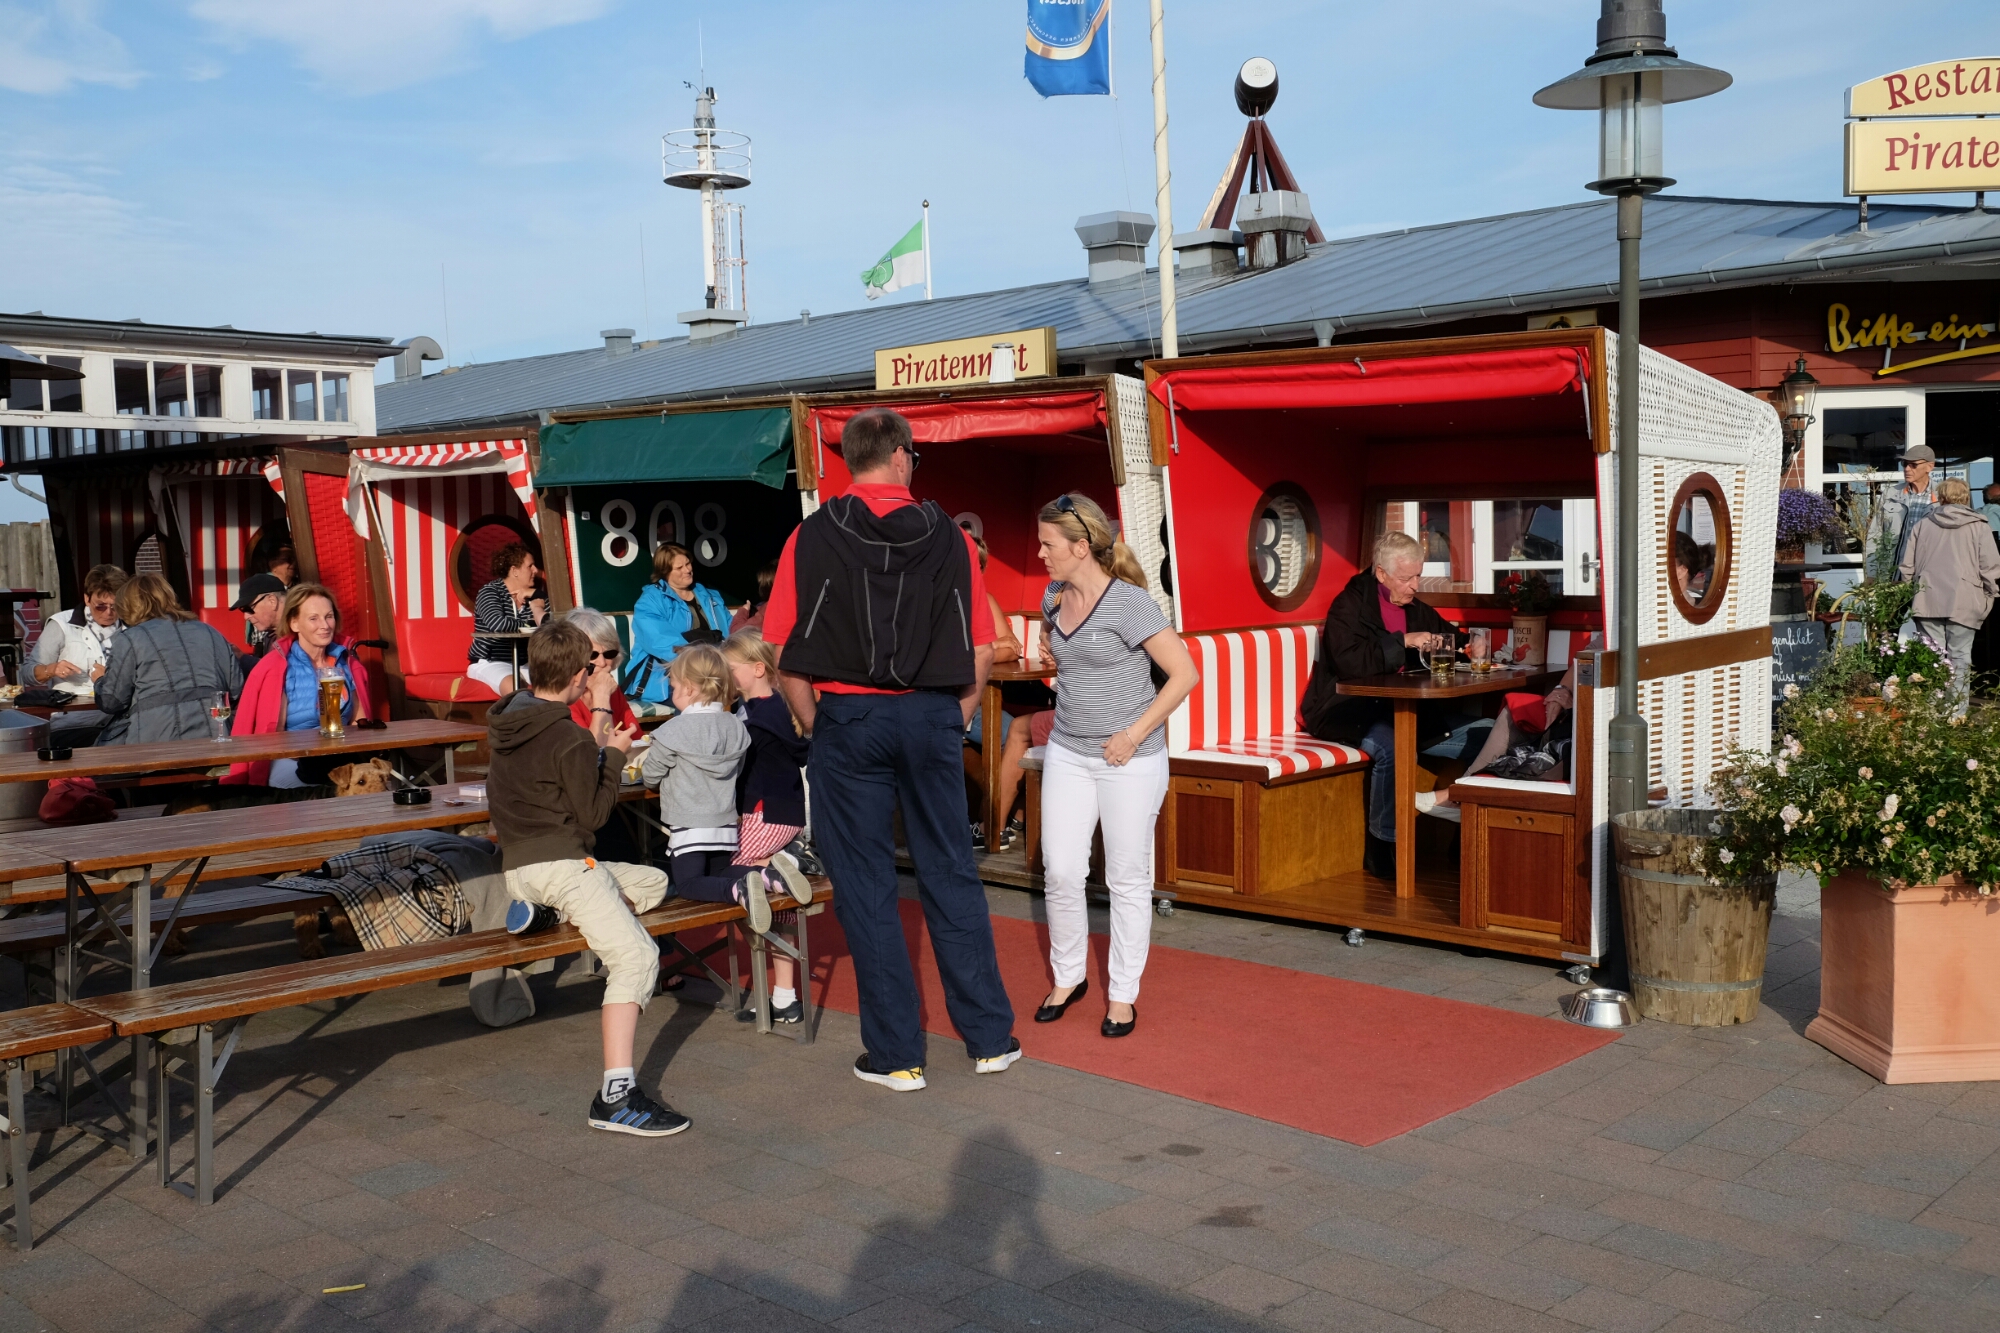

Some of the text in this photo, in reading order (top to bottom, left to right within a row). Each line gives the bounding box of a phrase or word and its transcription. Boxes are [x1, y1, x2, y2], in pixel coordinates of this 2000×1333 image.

[1884, 132, 2000, 172] Pirate
[1828, 303, 1988, 353] Bitte ein
[892, 344, 1028, 387] Piratennt
[600, 499, 728, 567] 808
[606, 1077, 629, 1098] G
